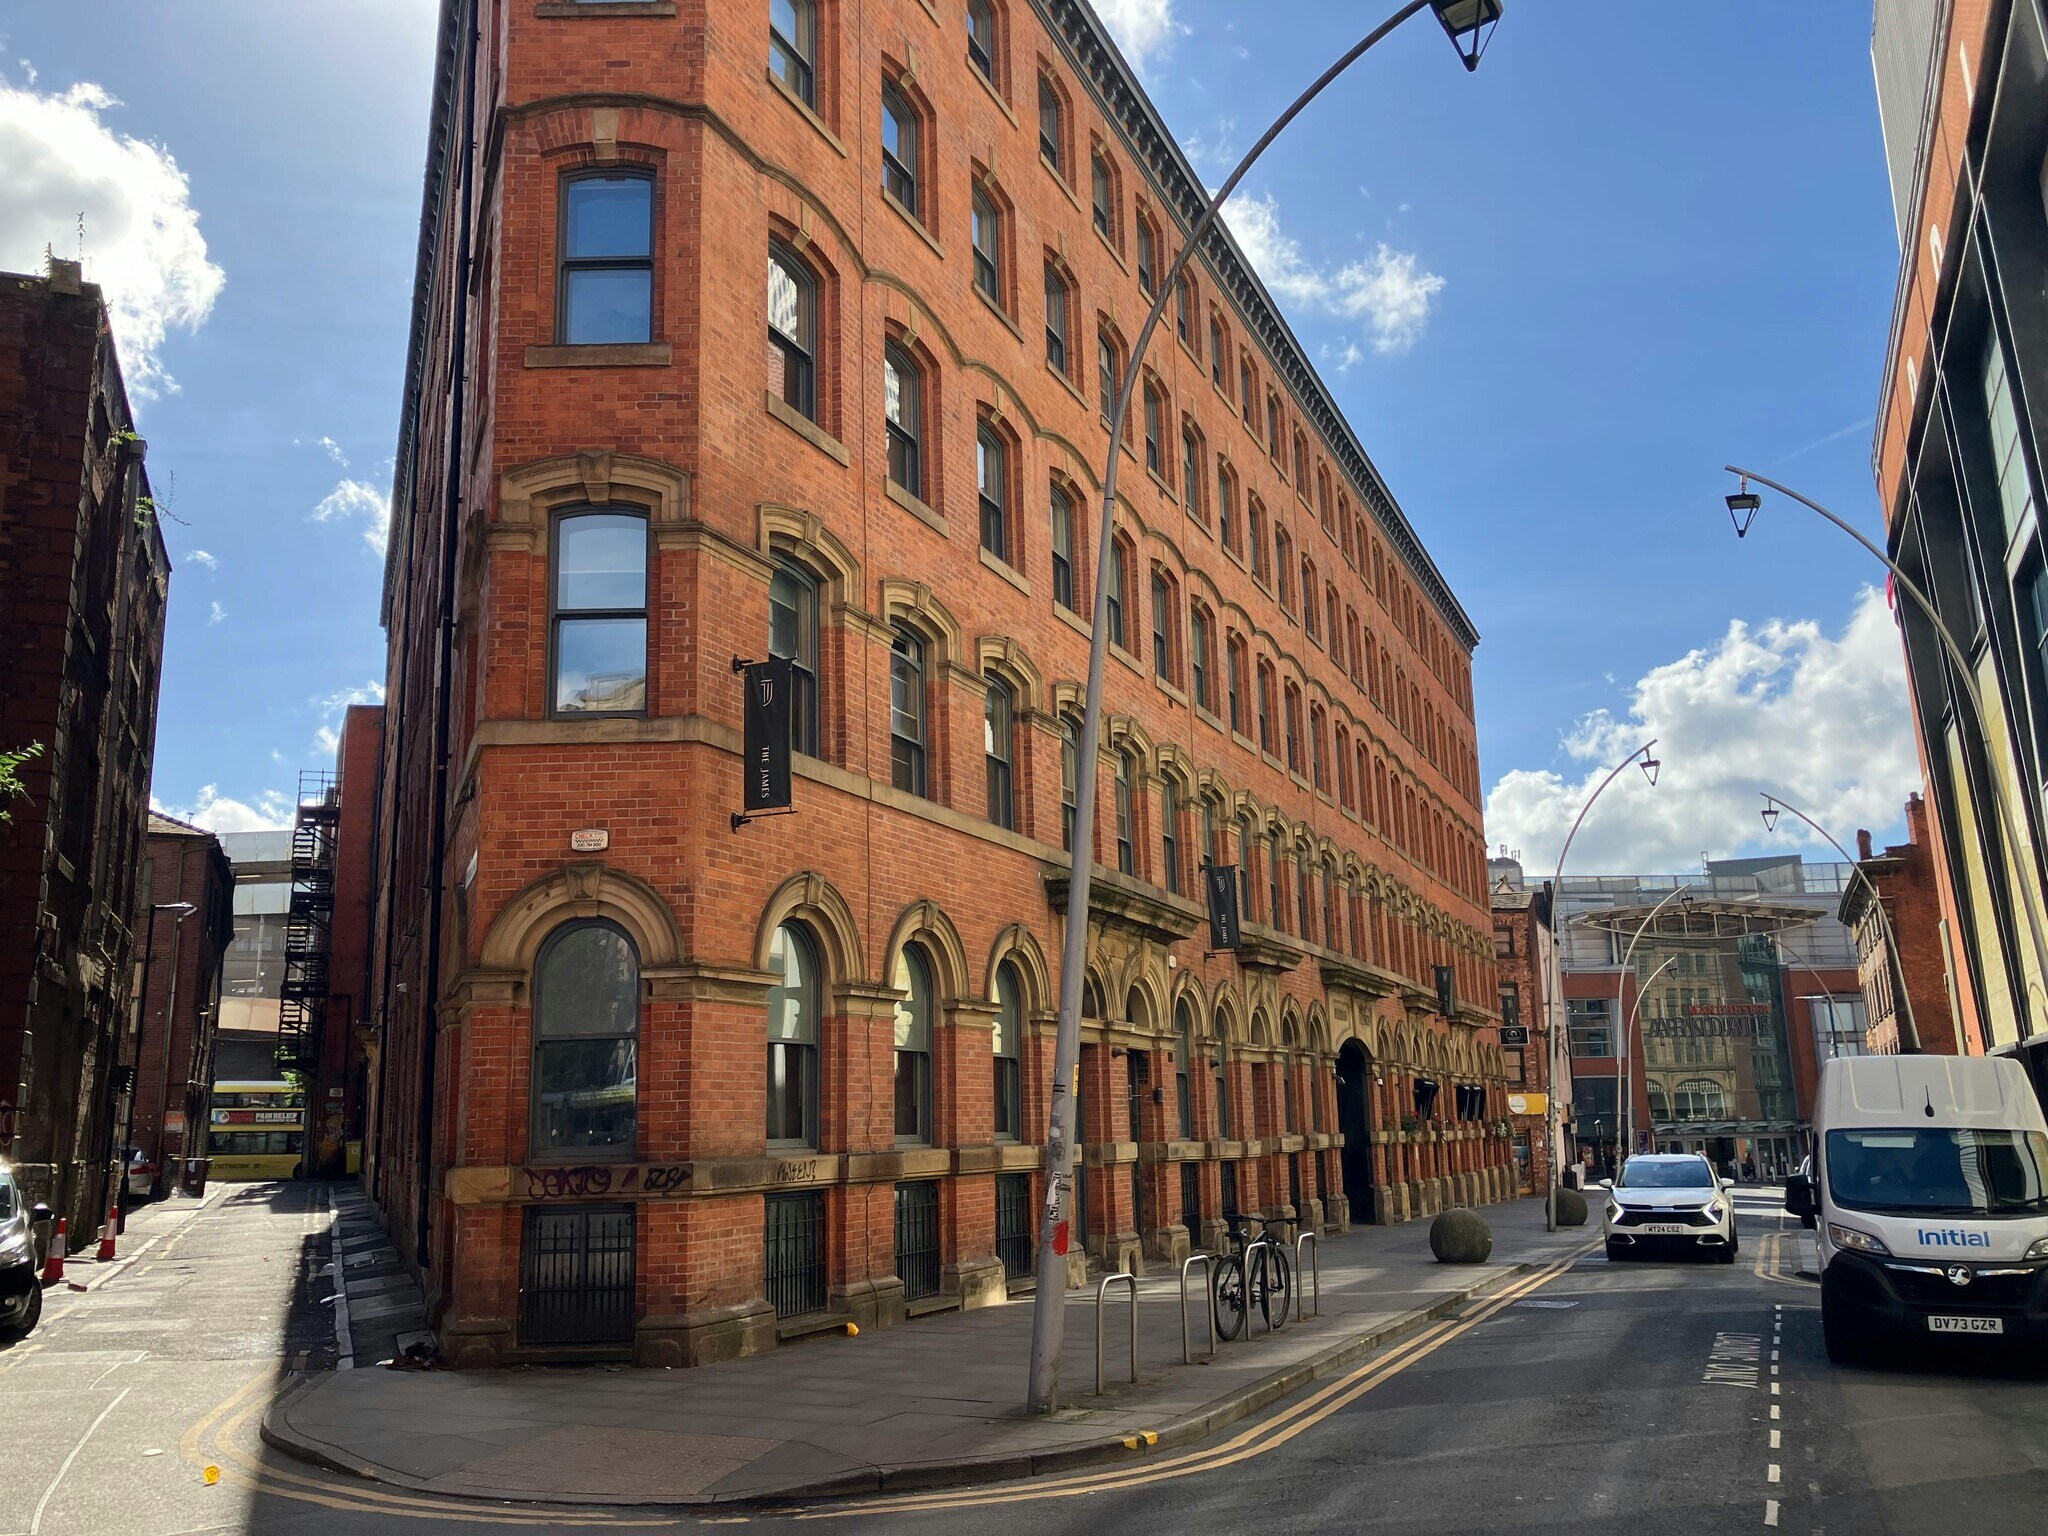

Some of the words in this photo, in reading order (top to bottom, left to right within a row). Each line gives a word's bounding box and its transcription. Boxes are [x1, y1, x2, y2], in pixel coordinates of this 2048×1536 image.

[761, 745, 770, 764] THE
[760, 768, 770, 799] JAMES
[1655, 1016, 1771, 1037] ARNDALE
[1917, 1229, 1991, 1248] Initial
[1934, 1317, 1968, 1330] DV73
[1971, 1319, 1997, 1331] GZR
